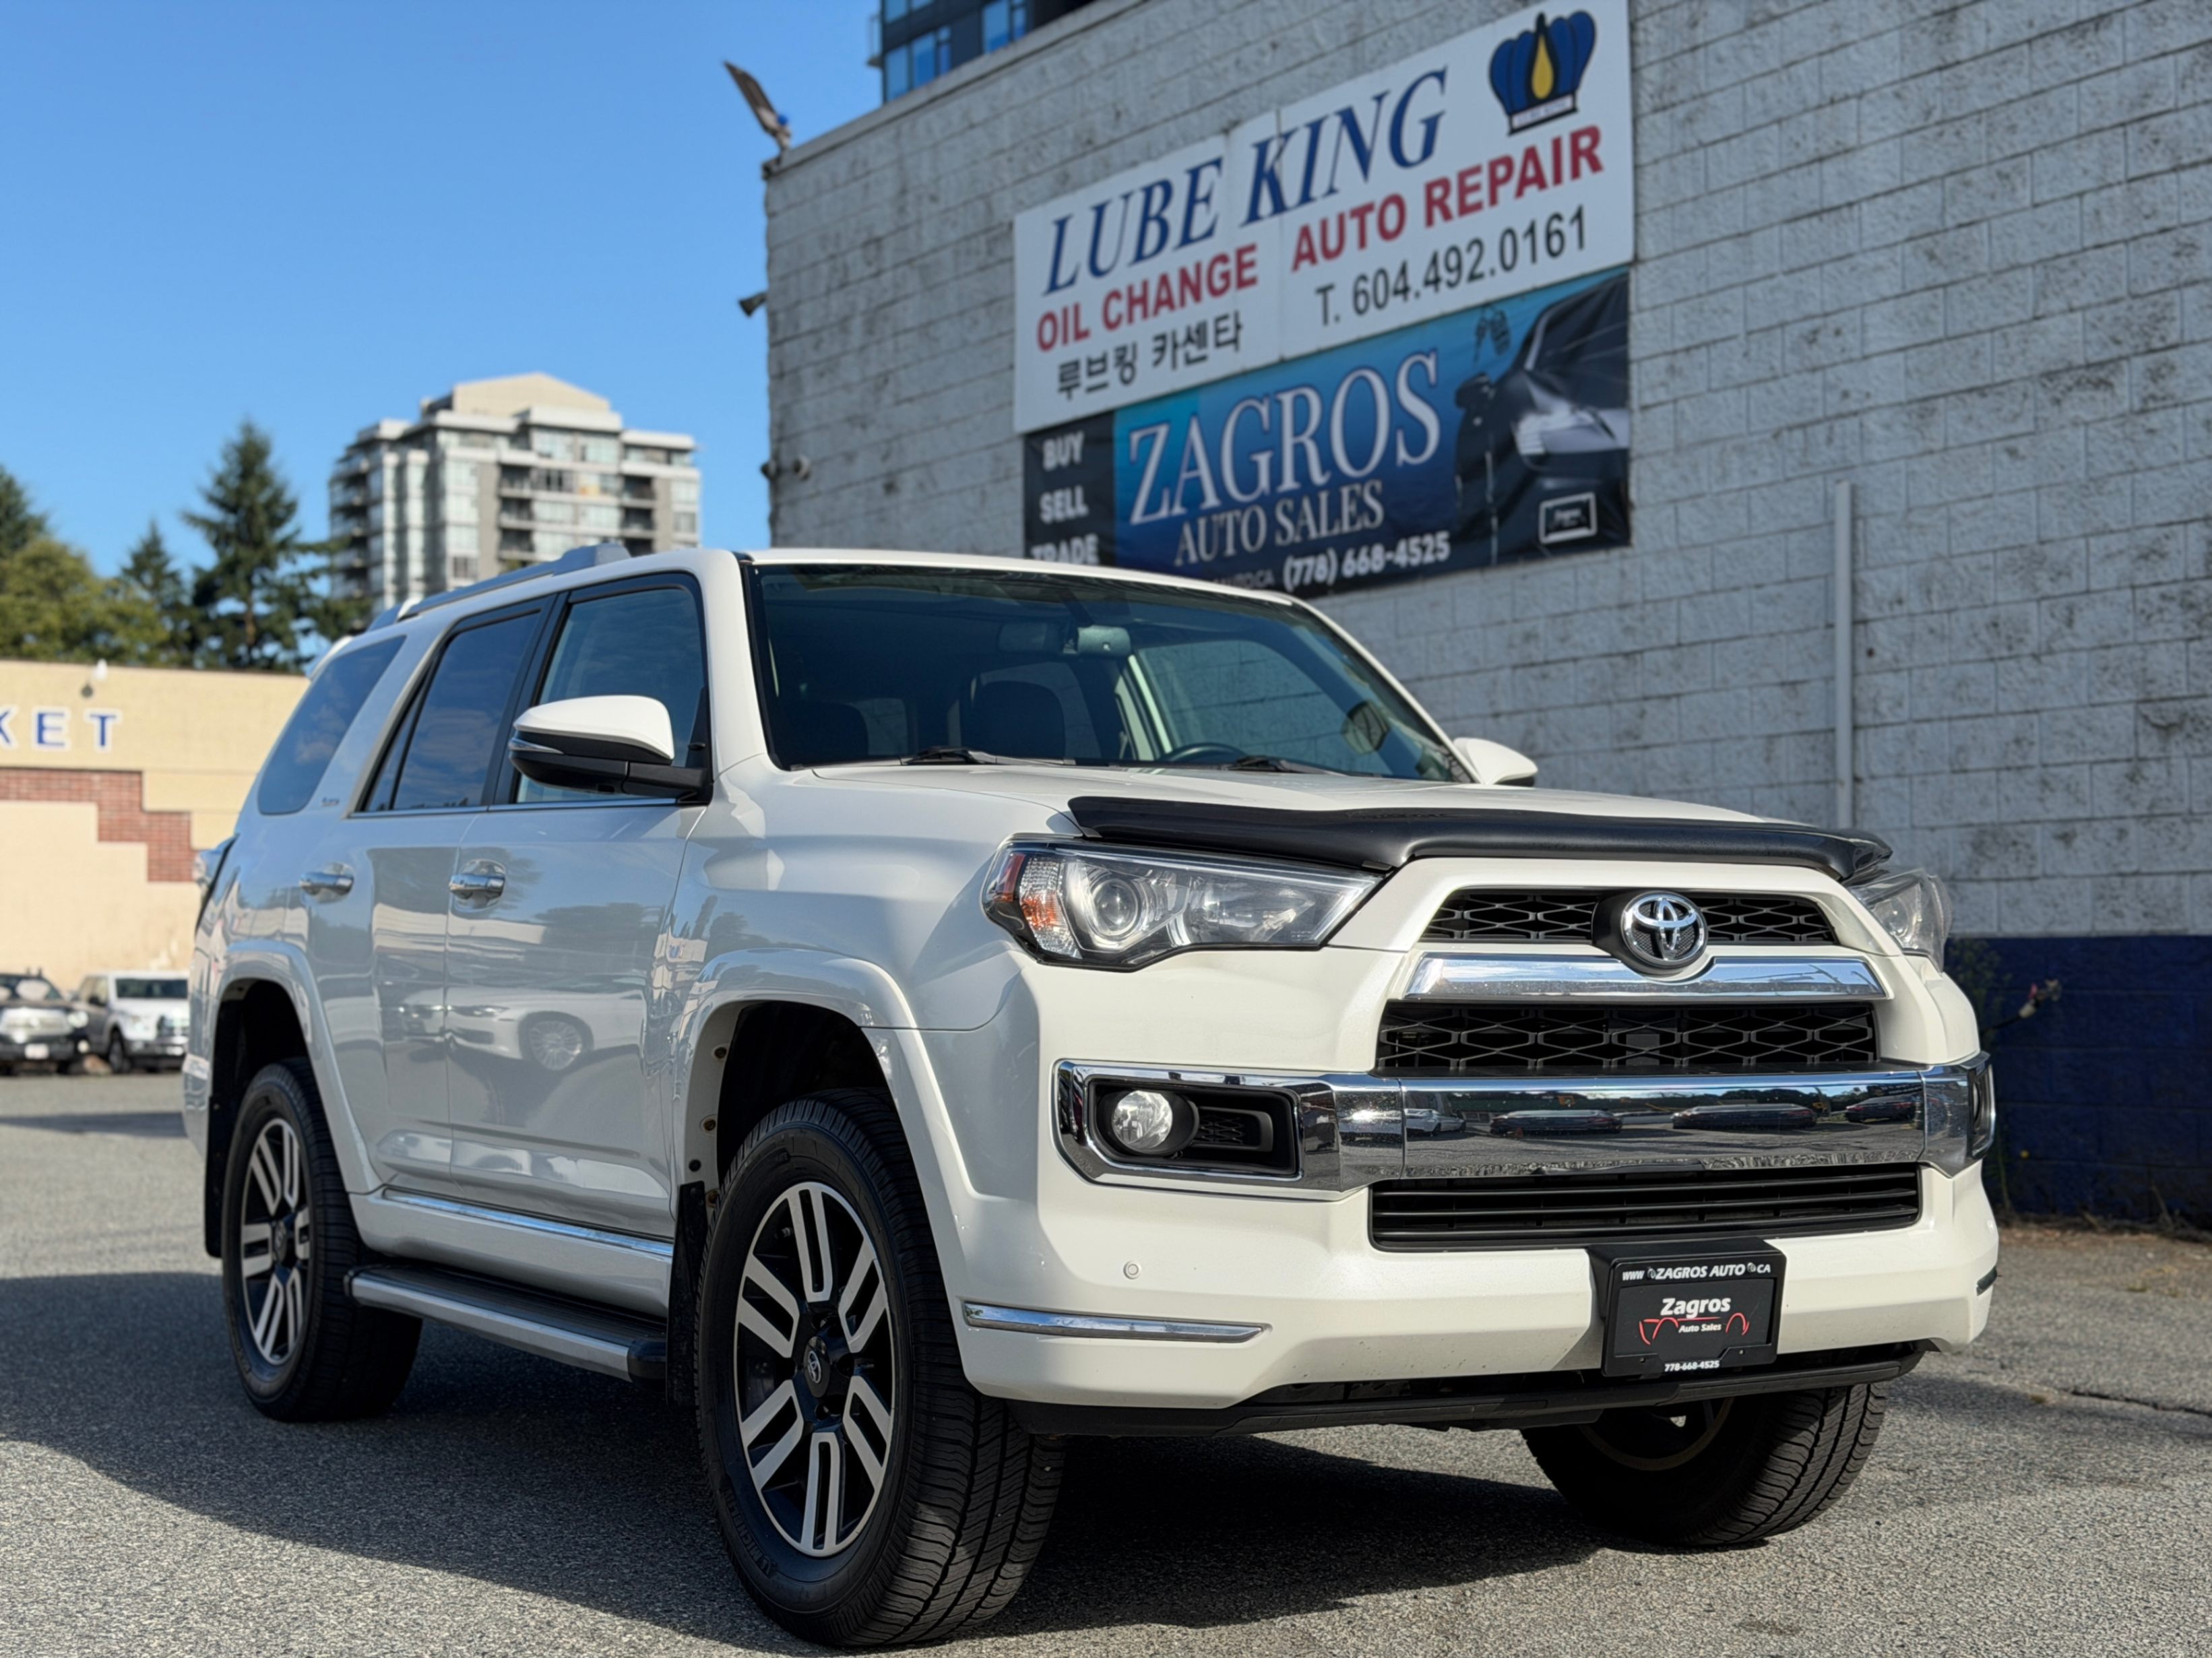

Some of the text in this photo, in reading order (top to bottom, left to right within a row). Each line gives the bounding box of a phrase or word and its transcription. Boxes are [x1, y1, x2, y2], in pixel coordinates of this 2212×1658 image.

[1044, 66, 1449, 295] LUBE KING
[1037, 125, 1604, 352] OIL CHANGE AUTO REPAIR
[1316, 205, 1586, 327] T. 604.492.0161
[1056, 311, 1243, 402] 루브킹 카센타
[1042, 430, 1084, 470] BUY
[1128, 348, 1441, 526] ZAGROS
[1040, 484, 1089, 524] SELL
[1175, 479, 1385, 567] AUTO SALES
[1284, 531, 1451, 592] (778) 668-4525
[1622, 1264, 1771, 1281] WWW ZAGROS AUTO CA
[1660, 1298, 1732, 1318] Zagros
[1678, 1323, 1721, 1333] Auto Sales
[1664, 1360, 1720, 1372] 778-668-4525
[724, 1489, 763, 1562] MICHELIN
